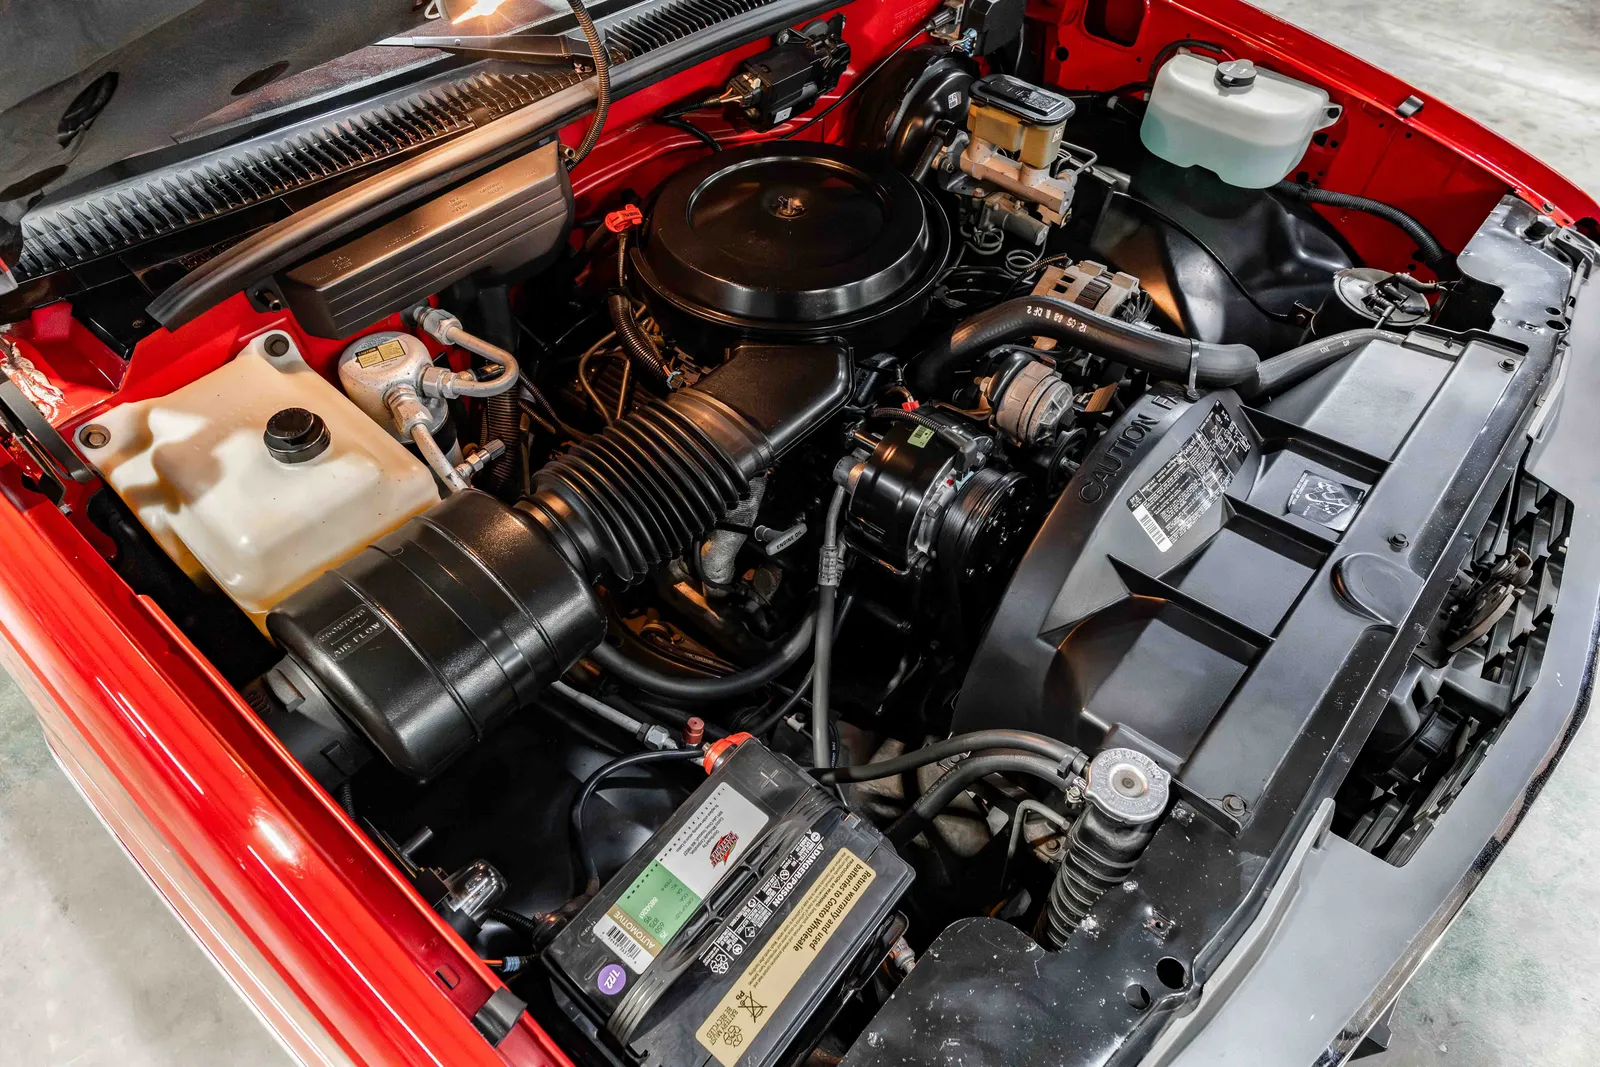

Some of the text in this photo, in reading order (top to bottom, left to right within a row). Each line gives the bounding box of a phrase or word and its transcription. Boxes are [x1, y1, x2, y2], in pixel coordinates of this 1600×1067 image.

[1025, 304, 1032, 314] 2
[1071, 406, 1161, 508] CAUTION
[775, 535, 795, 549] ENGINE
[332, 641, 351, 657] AIR
[351, 621, 381, 643] FLOW
[708, 830, 734, 861] BATTERIES
[710, 833, 739, 867] INTERSTATE
[771, 848, 821, 907] DANGER/POISON
[832, 857, 854, 884] PROPOSITION
[638, 896, 658, 919] 8850261
[642, 914, 652, 924] 95
[791, 862, 863, 953] batteries to Costco Wholesale
[807, 869, 872, 951] Return warranty and used
[611, 910, 657, 950] AUTOMOTIVE
[647, 916, 659, 929] 875
[653, 921, 665, 934] 650
[658, 929, 668, 939] 75
[601, 967, 622, 990] 7/22
[733, 988, 746, 1002] Pb
[705, 1005, 732, 1038] BE RECYCLED
[708, 1008, 738, 1045] BATTERY MUST
